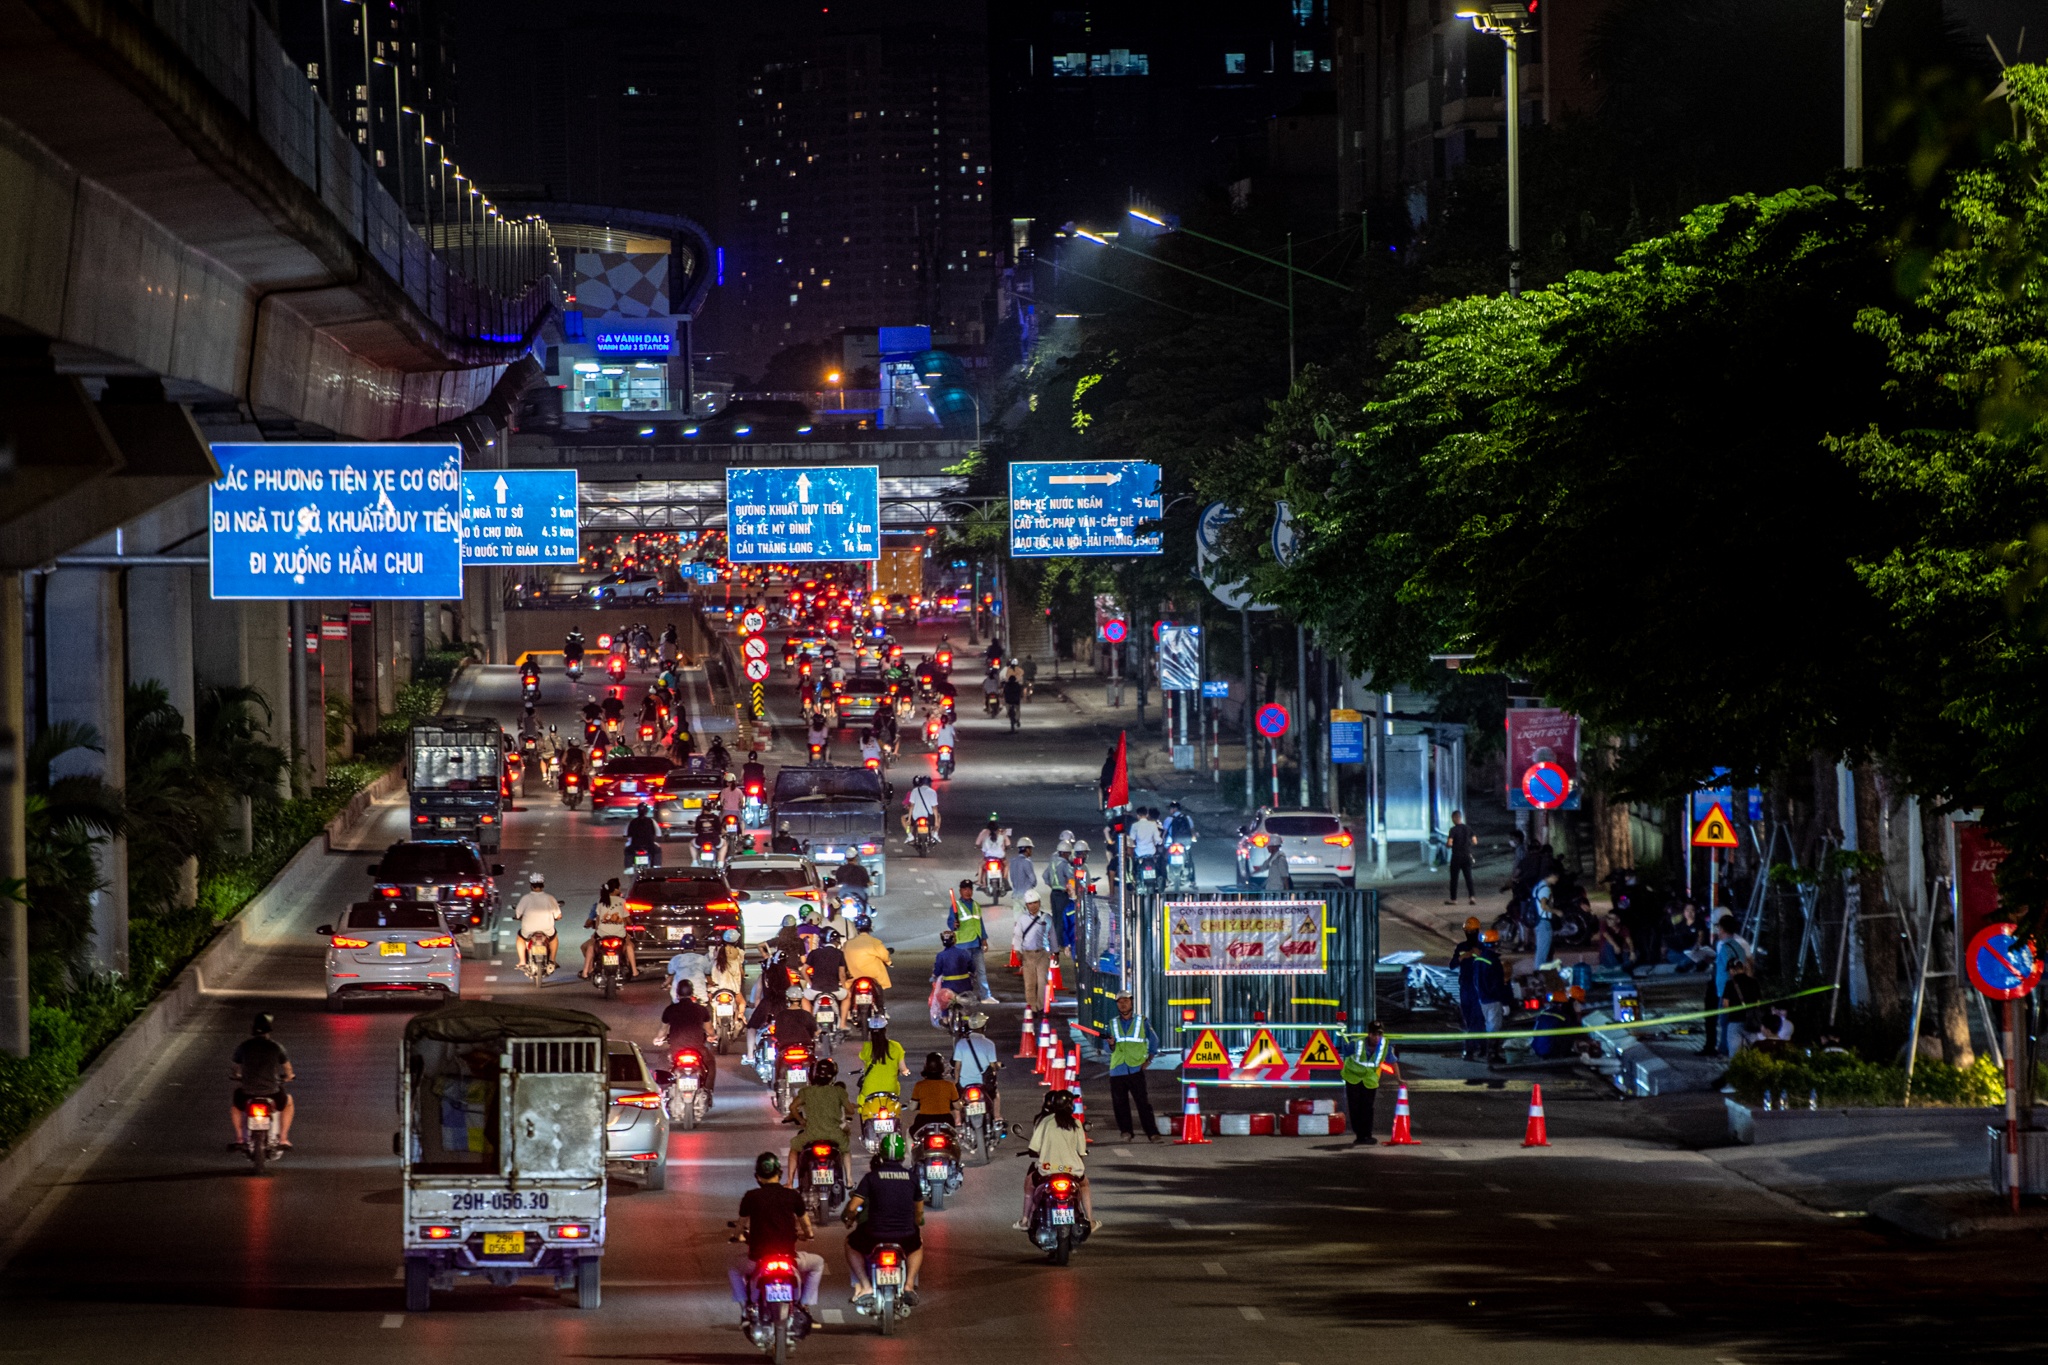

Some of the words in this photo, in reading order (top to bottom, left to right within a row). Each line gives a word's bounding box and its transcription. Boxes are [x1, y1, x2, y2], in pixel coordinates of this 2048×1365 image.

[597, 334, 612, 343] GA
[663, 334, 670, 343] 3
[254, 467, 324, 491] PHƯƠNG
[328, 464, 368, 494] TIỆN
[372, 469, 396, 491] XE
[400, 468, 424, 491] CƠ
[769, 500, 798, 515] KHUẤT
[801, 503, 819, 515] DUY
[823, 500, 844, 515] TIẾN
[1013, 496, 1032, 510] BẾN
[1034, 499, 1047, 510] XE
[1049, 495, 1075, 510] NƯỚC
[1136, 497, 1142, 508] 5
[1144, 497, 1159, 508] km
[213, 510, 231, 533] ĐI
[234, 506, 268, 533] NGÃ
[270, 509, 295, 533] TƯ
[327, 503, 381, 533] KHUẤT
[384, 510, 419, 533] DUY
[422, 503, 459, 533] TIẾN
[472, 504, 492, 519] NGÃ
[495, 507, 508, 519] TƯ
[510, 503, 524, 519] SỞ
[550, 506, 557, 518] 3
[559, 506, 574, 518] km
[735, 520, 754, 535] BẾN
[757, 523, 769, 535] XE
[772, 521, 785, 535] MỸ
[789, 520, 811, 535] ĐÌNH
[848, 521, 855, 534] 6
[857, 522, 872, 533] km
[1013, 518, 1032, 529] CAO
[1034, 514, 1051, 529] TỐC
[1052, 514, 1076, 528] PHÁP
[473, 524, 480, 538] Ô
[504, 522, 524, 538] DỪA
[541, 525, 558, 538] 4.5
[559, 525, 574, 538] km
[758, 540, 787, 554] THĂNG
[789, 542, 813, 554] LONG
[843, 540, 855, 553] 14
[857, 540, 872, 552] km
[1052, 533, 1065, 547] HÀ
[1146, 536, 1160, 546] km
[474, 542, 499, 557] QUỐC
[501, 541, 513, 557] TỬ
[515, 542, 539, 557] GIÁM
[544, 545, 558, 557] 6.3
[560, 545, 575, 556] km
[249, 551, 267, 574] ĐI
[272, 544, 332, 575] XUỐNG
[338, 545, 378, 574] HẦM
[384, 552, 424, 574] CHUI
[1517, 729, 1547, 740] LIGHT
[1547, 727, 1570, 737] BOX
[1971, 857, 2004, 873] LIG
[1204, 1041, 1213, 1049] ĐI
[1195, 1052, 1221, 1063] CHẬM
[878, 1171, 910, 1180] VIETNAM
[453, 1192, 549, 1210] 29H-056.30
[496, 1234, 513, 1243] 29H
